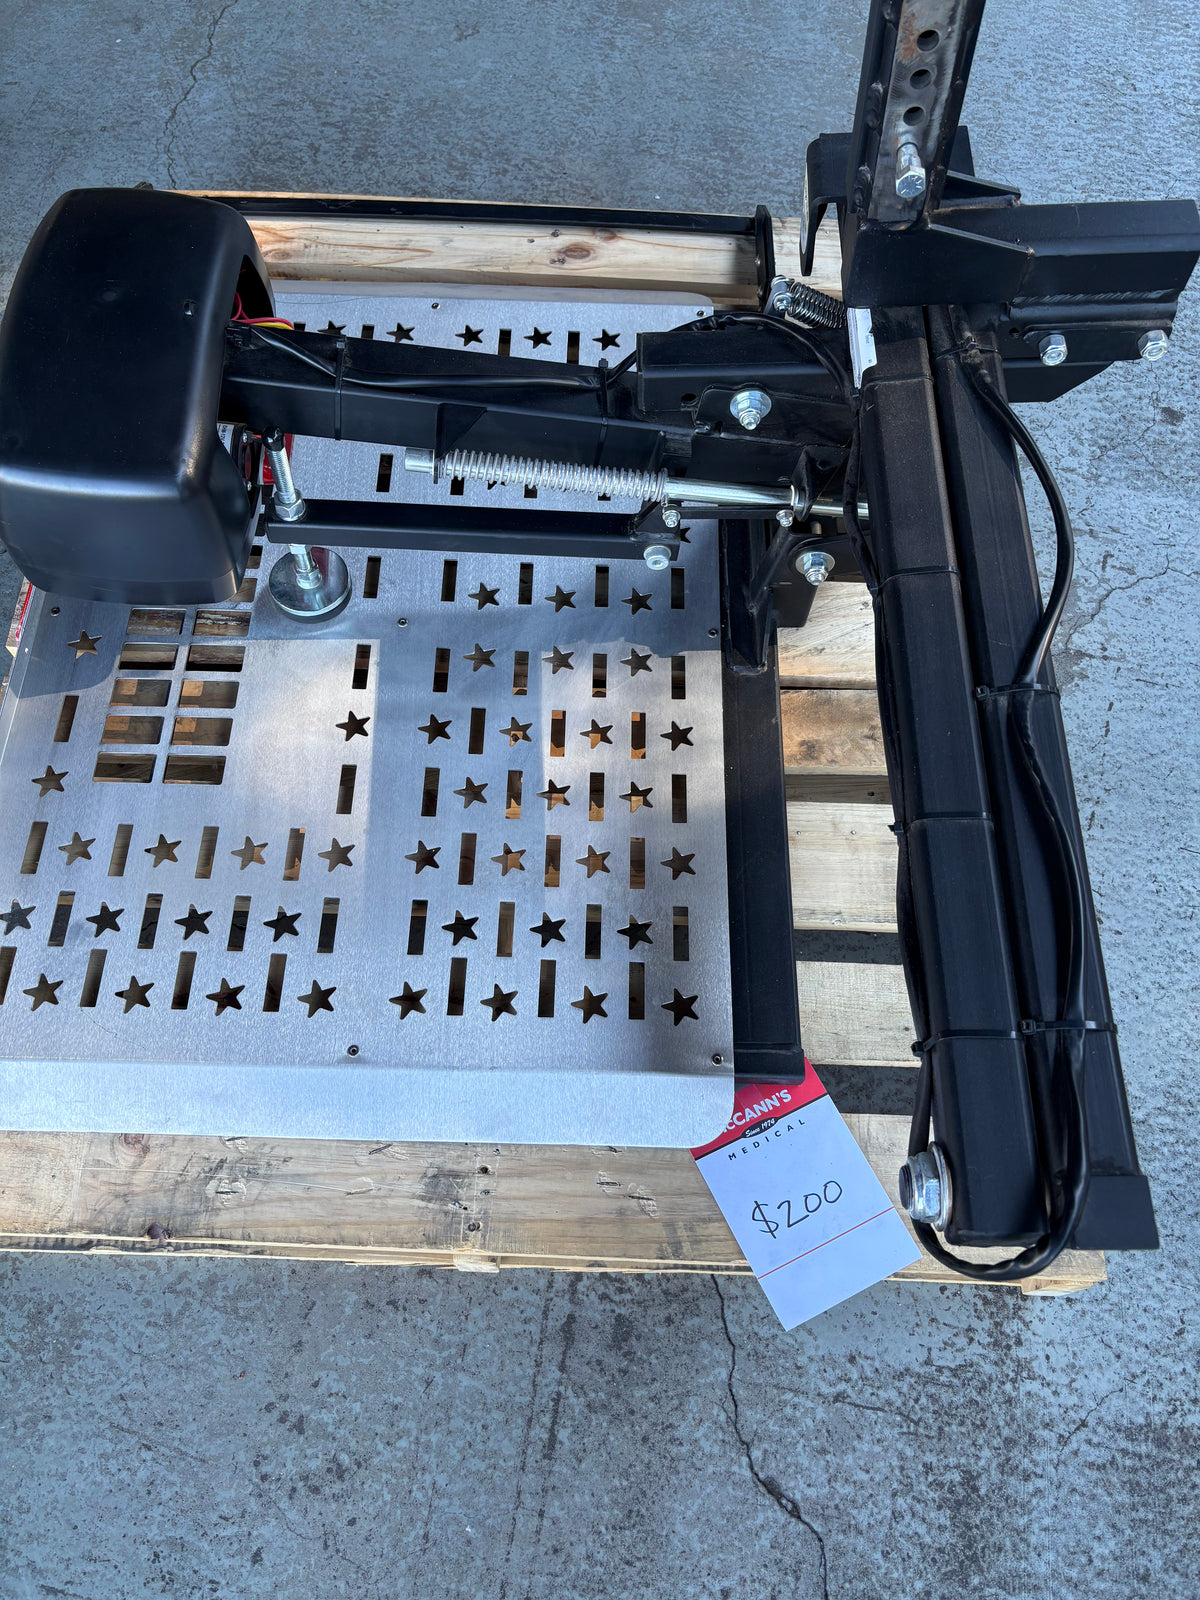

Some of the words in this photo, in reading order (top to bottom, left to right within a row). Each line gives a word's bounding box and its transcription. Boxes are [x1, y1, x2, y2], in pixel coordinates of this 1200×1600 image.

[728, 1119, 805, 1161] MEDICAL
[761, 1118, 776, 1130] 1974
[752, 1180, 842, 1239] $200
